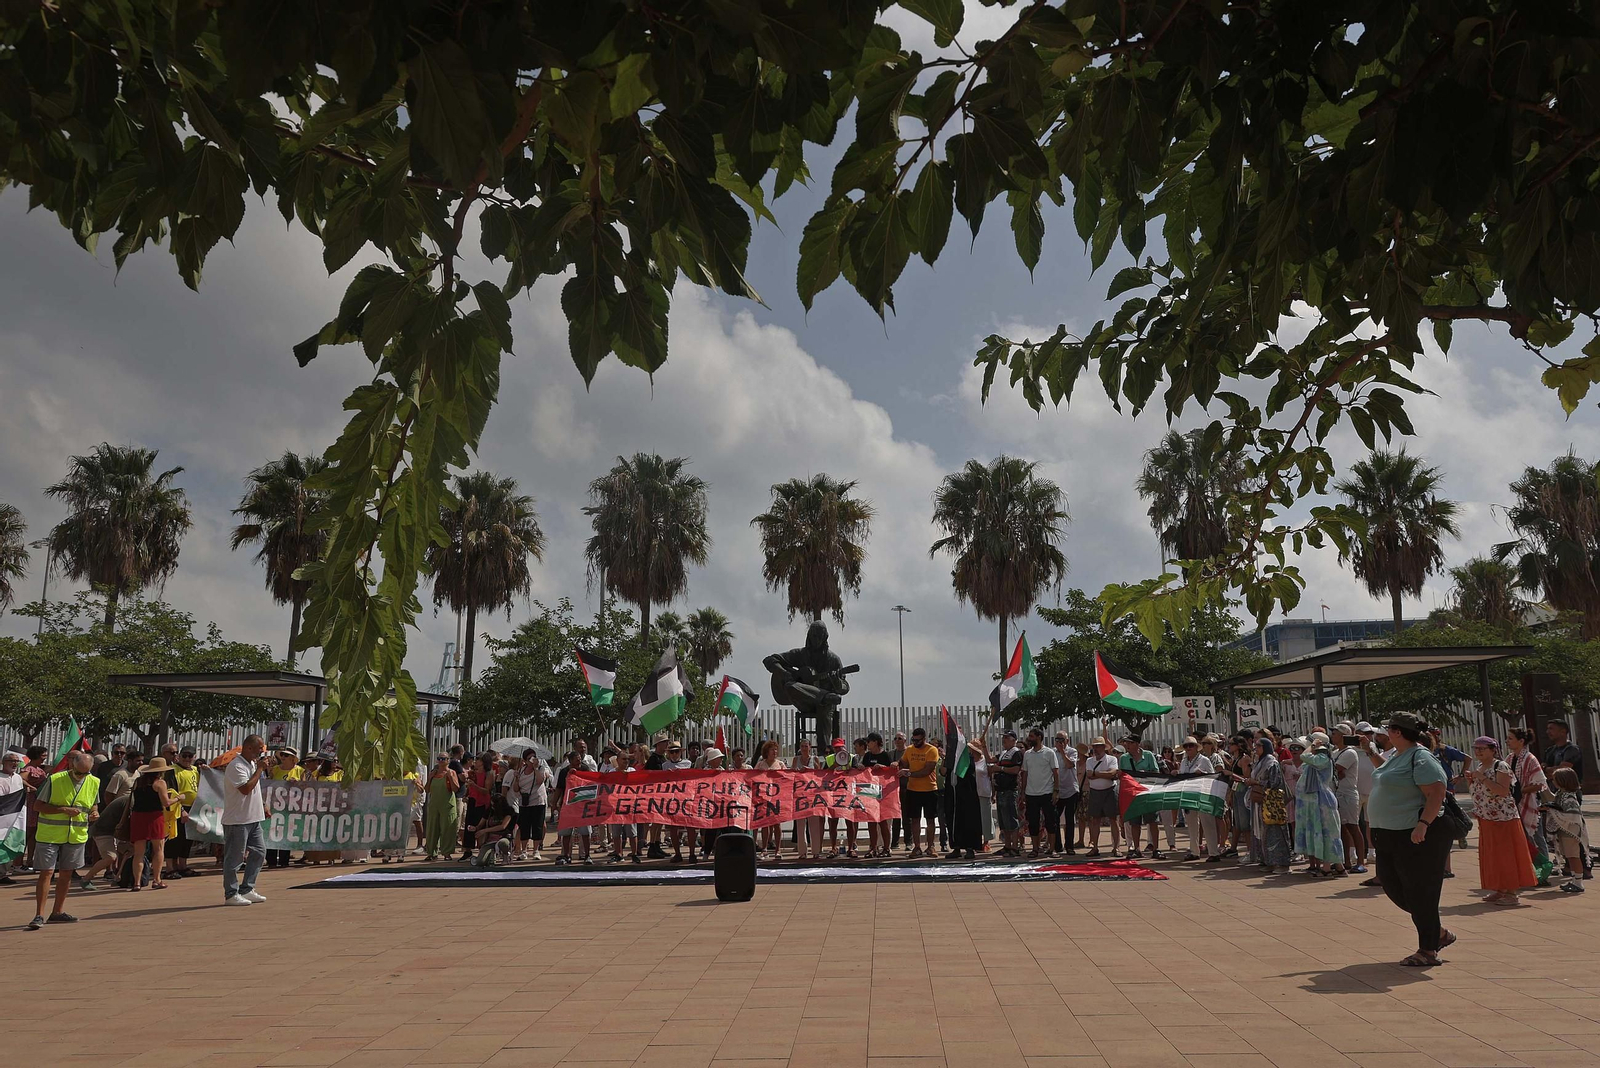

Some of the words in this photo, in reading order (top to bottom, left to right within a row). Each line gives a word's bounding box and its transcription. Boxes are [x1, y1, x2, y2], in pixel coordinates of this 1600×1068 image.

[265, 786, 348, 812] ISRAEL:
[696, 781, 780, 798] PUERTO
[793, 777, 848, 793] PARA
[581, 799, 608, 819] EL
[615, 796, 742, 819] GENOCIDIO
[753, 799, 780, 821] EN
[795, 794, 866, 812] GAZA
[270, 812, 403, 843] GENOCIDIO
